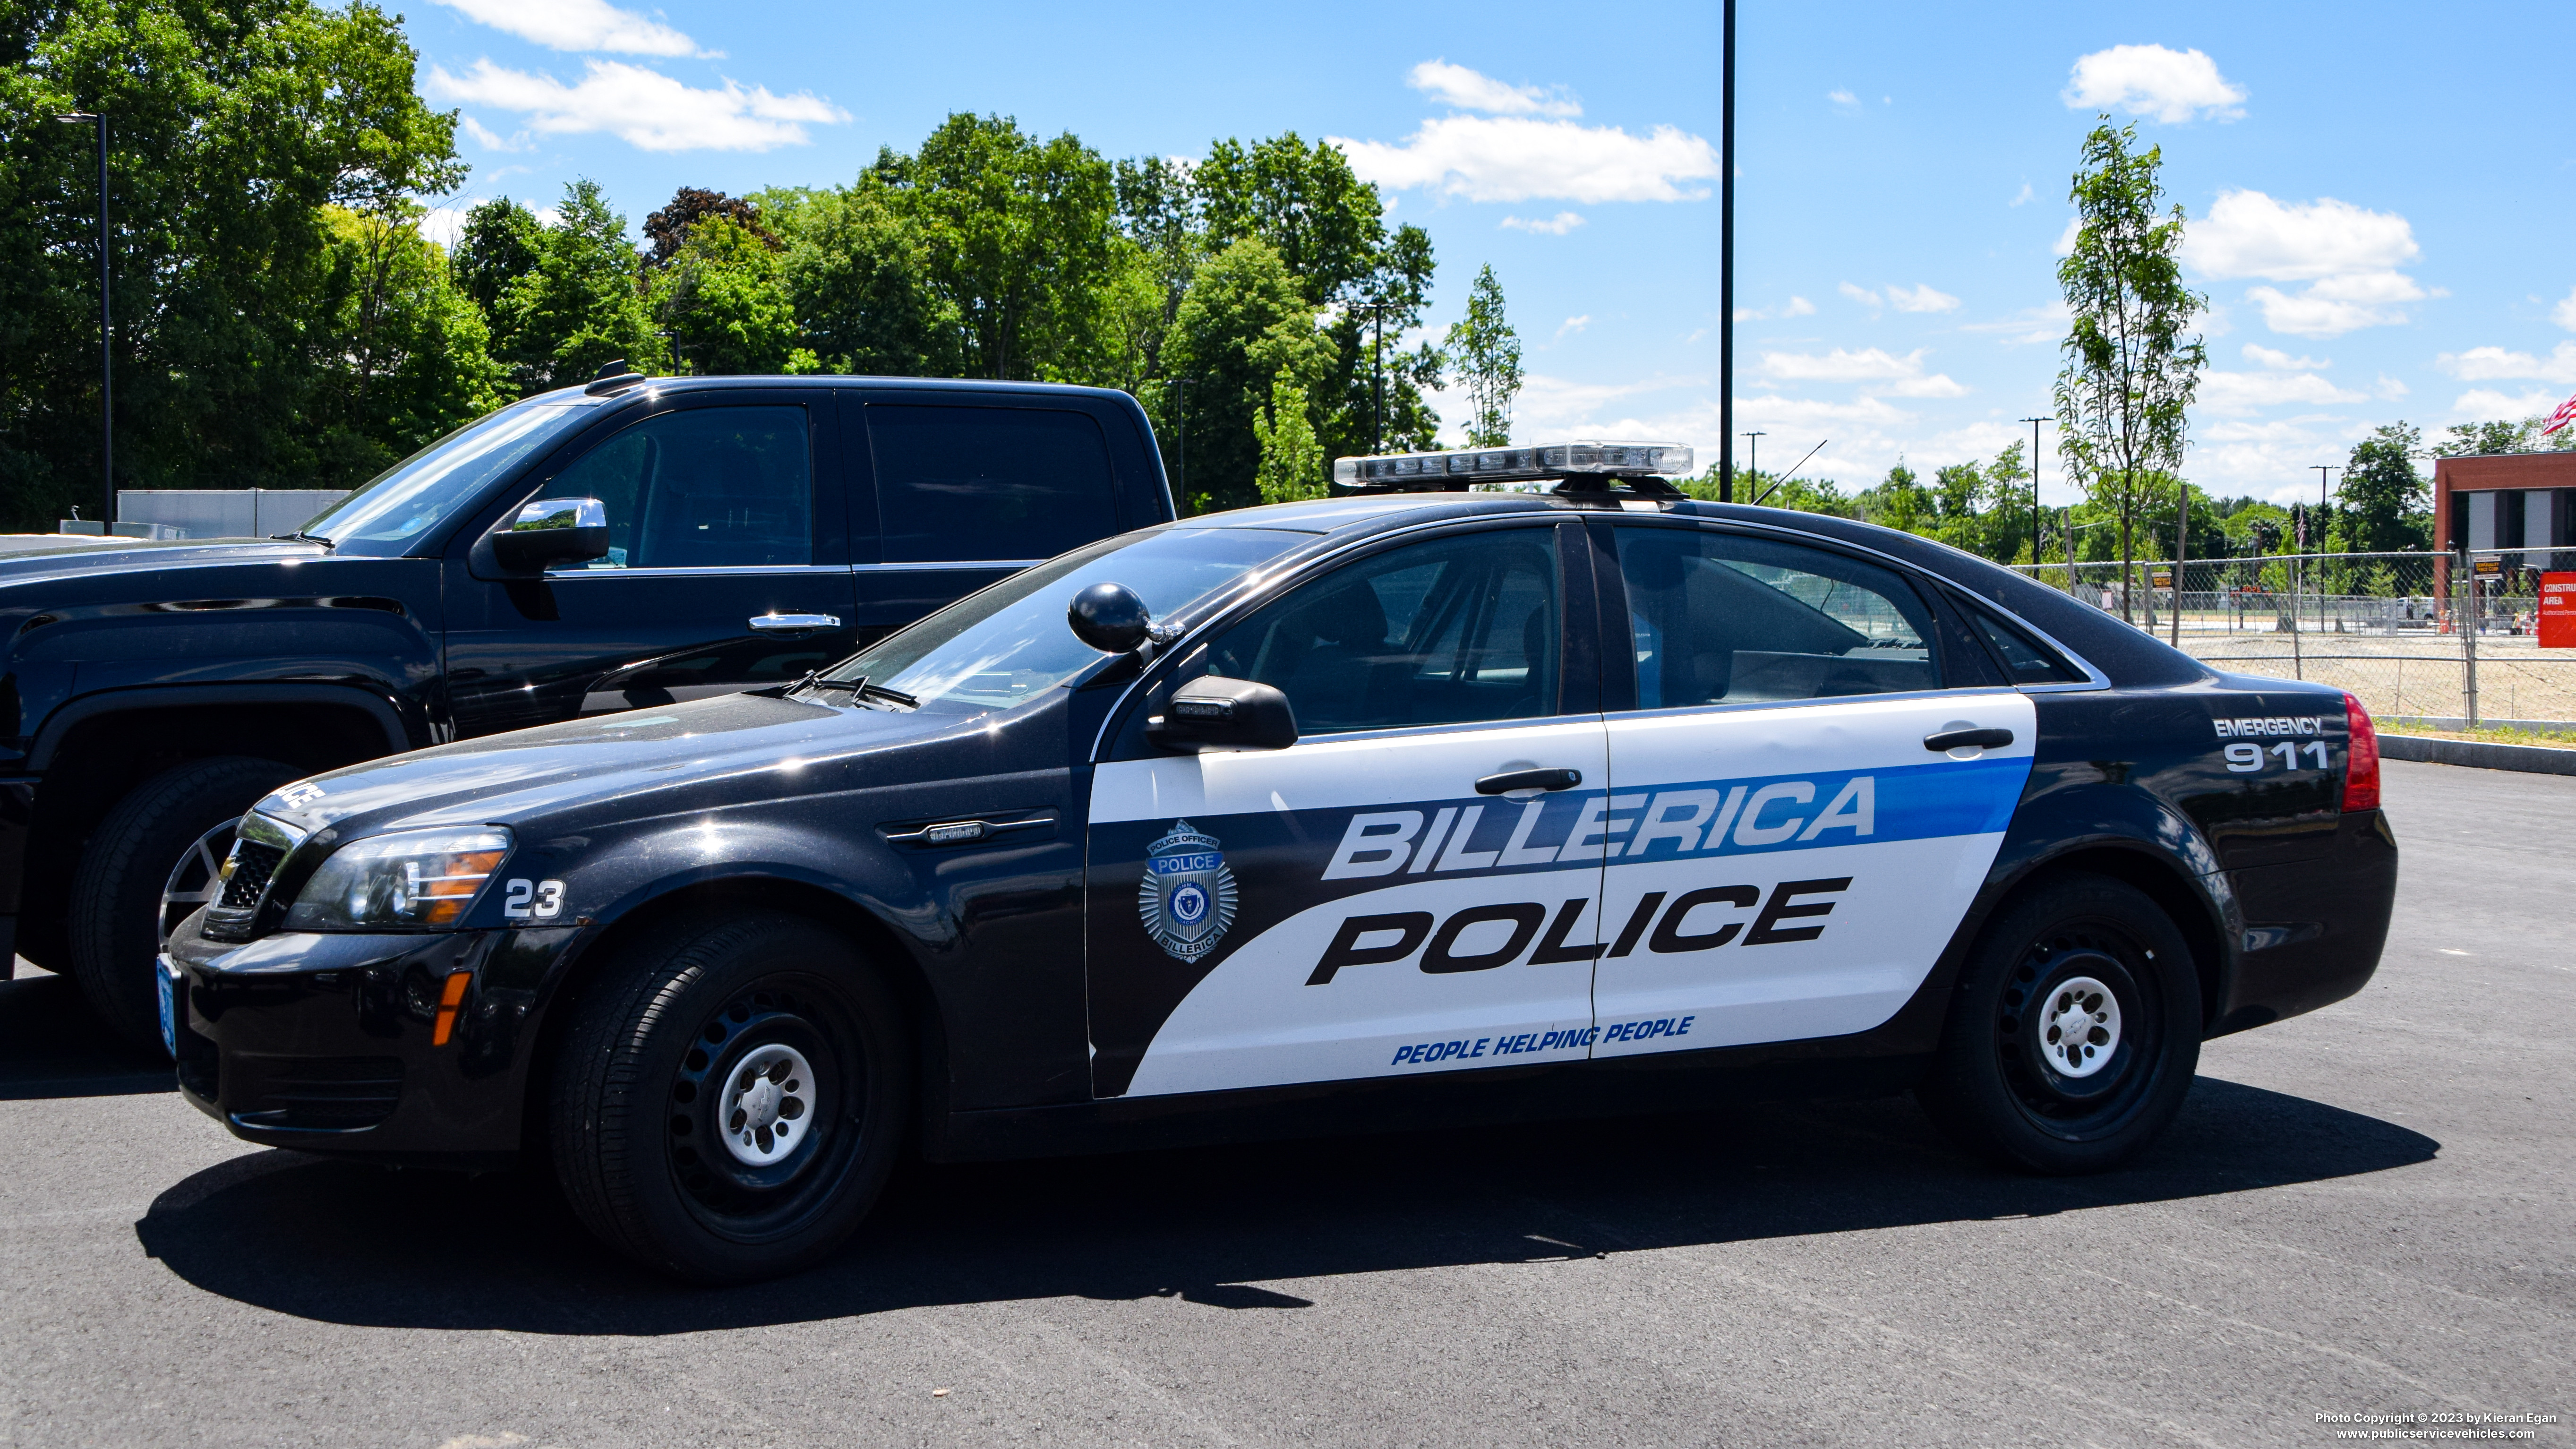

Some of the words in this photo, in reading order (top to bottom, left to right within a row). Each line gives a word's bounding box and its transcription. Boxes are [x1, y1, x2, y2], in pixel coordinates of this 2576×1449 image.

[2543, 596, 2563, 605] AREA
[2213, 717, 2322, 737] EMERGENCY
[2224, 741, 2328, 772] 911
[1320, 776, 1874, 881] BILLERICA
[1150, 835, 1180, 853] POLICE
[1181, 835, 1218, 847] OFFICER
[1158, 855, 1215, 873] POLICE
[505, 878, 565, 918] 23
[1161, 933, 1221, 953] BILLERICA
[1304, 876, 1854, 986] POLICE
[1392, 1038, 1489, 1065] PEOPLE
[1493, 1026, 1601, 1055] HELPING
[1603, 1016, 1695, 1043] PEOPLE
